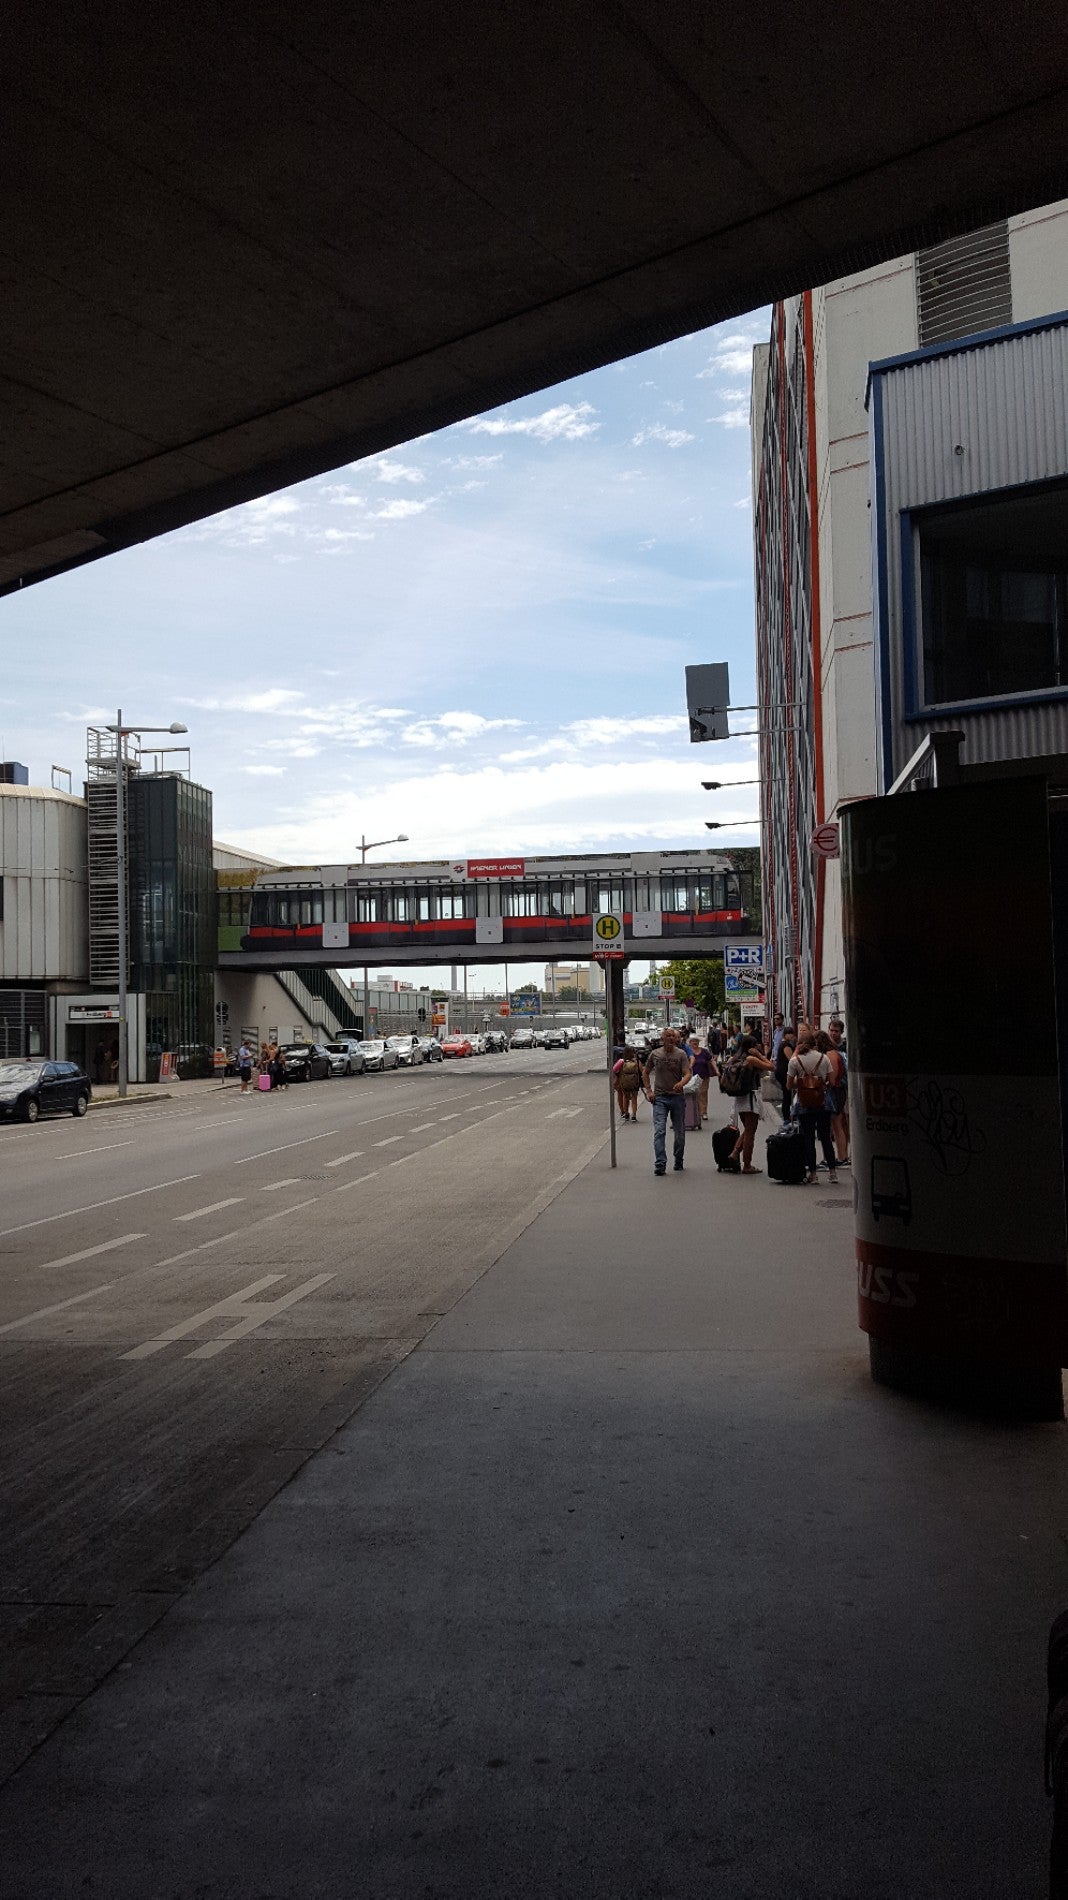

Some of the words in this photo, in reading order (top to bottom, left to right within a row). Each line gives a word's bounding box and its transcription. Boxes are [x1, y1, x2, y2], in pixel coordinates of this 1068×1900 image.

[602, 920, 614, 935] H
[727, 948, 761, 963] P+R
[869, 1082, 900, 1109] U3
[866, 1117, 909, 1136] Erdberg
